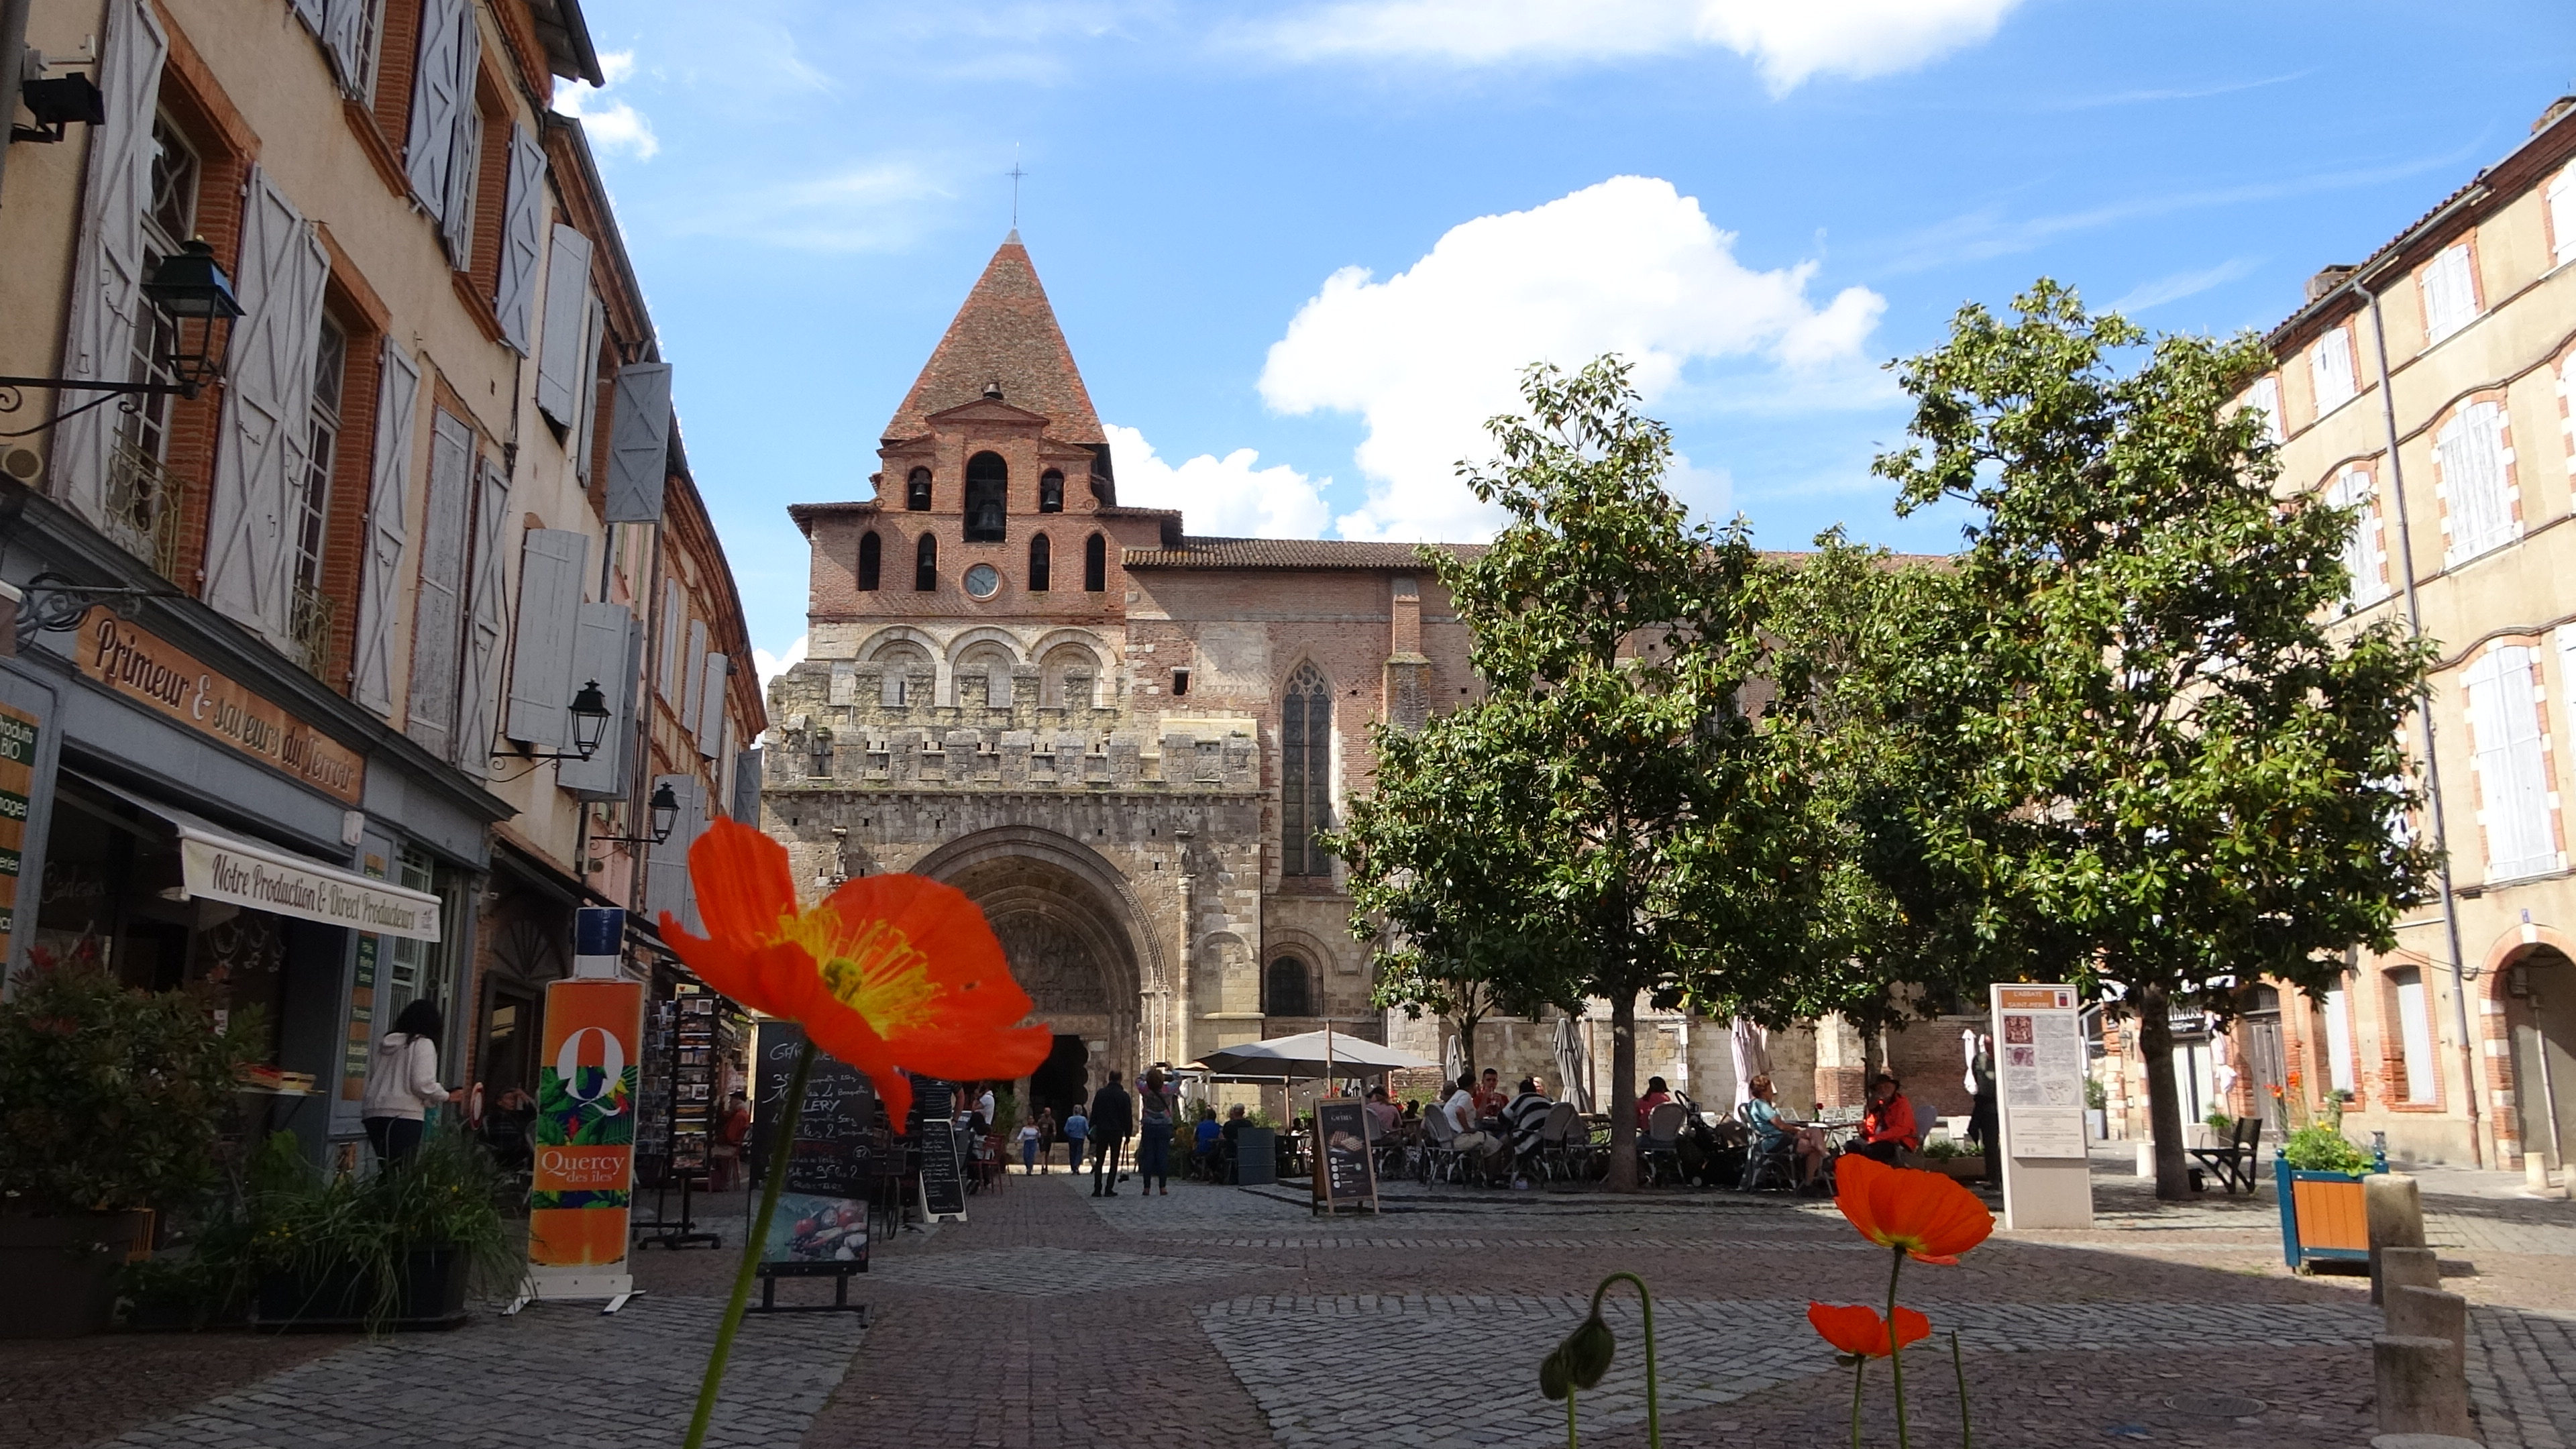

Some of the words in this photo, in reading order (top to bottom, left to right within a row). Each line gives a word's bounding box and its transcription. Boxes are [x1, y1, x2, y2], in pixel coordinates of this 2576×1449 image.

[95, 618, 190, 710] Primeur
[192, 673, 212, 720] &
[213, 698, 281, 759] saveurs
[282, 726, 304, 770] du
[305, 734, 355, 794] Terroir
[1, 739, 21, 759] BIO
[212, 853, 250, 896] Notre
[252, 864, 315, 912] Production
[317, 881, 326, 913] &
[329, 884, 360, 920] Direct
[362, 892, 415, 930] Producteurs
[557, 1026, 625, 1117] Q
[541, 1150, 626, 1176] Quercy
[566, 1171, 588, 1183] des
